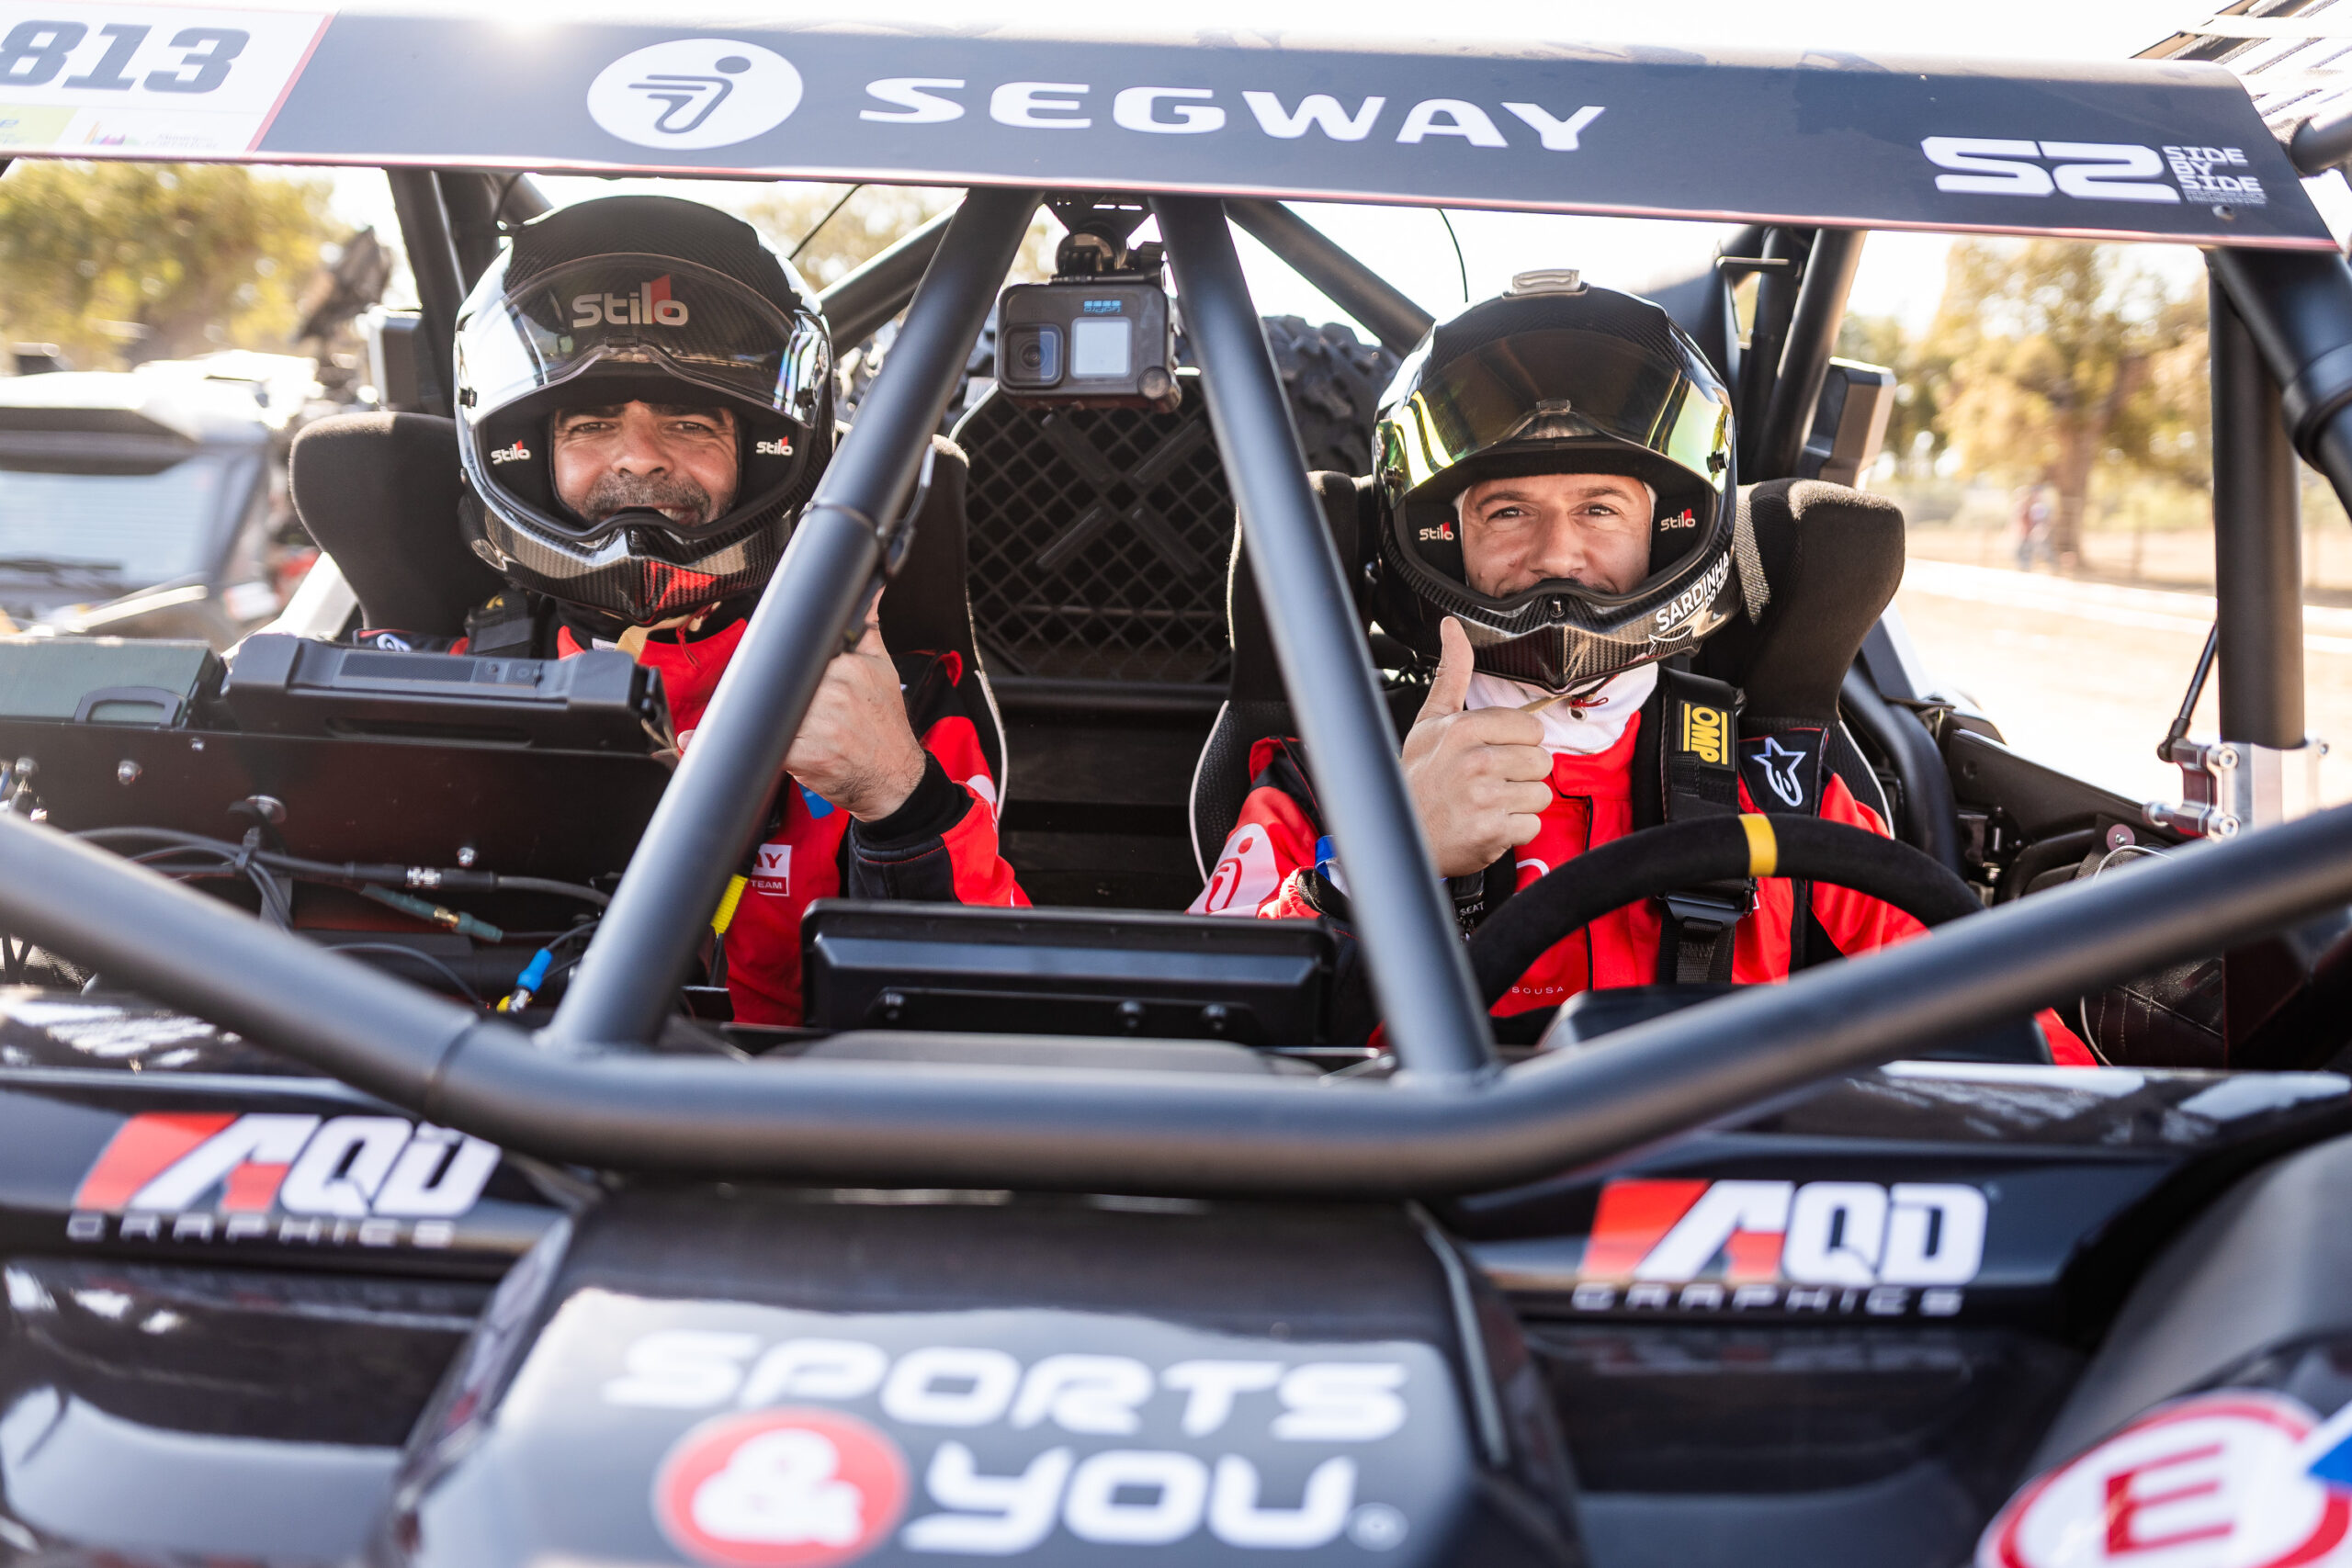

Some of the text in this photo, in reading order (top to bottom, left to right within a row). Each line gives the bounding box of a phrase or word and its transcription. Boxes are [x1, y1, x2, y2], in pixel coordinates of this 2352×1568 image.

[0, 19, 250, 94] 813
[858, 77, 1606, 152] SEGWAY
[1920, 136, 2181, 204] S2
[2161, 145, 2248, 165] SIDE
[2168, 160, 2212, 176] BY
[2177, 175, 2265, 194] SIDE
[1656, 551, 1729, 631] SARDINHA
[1691, 706, 1720, 763] OMP
[751, 880, 783, 889] TEAM
[1511, 986, 1564, 995] SOUSA
[72, 1111, 503, 1218] AQD
[66, 1212, 456, 1247] GRAPHICS
[1577, 1179, 1988, 1287] AQD
[1570, 1283, 1963, 1315] GRAPHICS
[602, 1330, 1409, 1442] SPORTS
[689, 1427, 1358, 1556] & YOU
[2103, 1441, 2235, 1560] E
